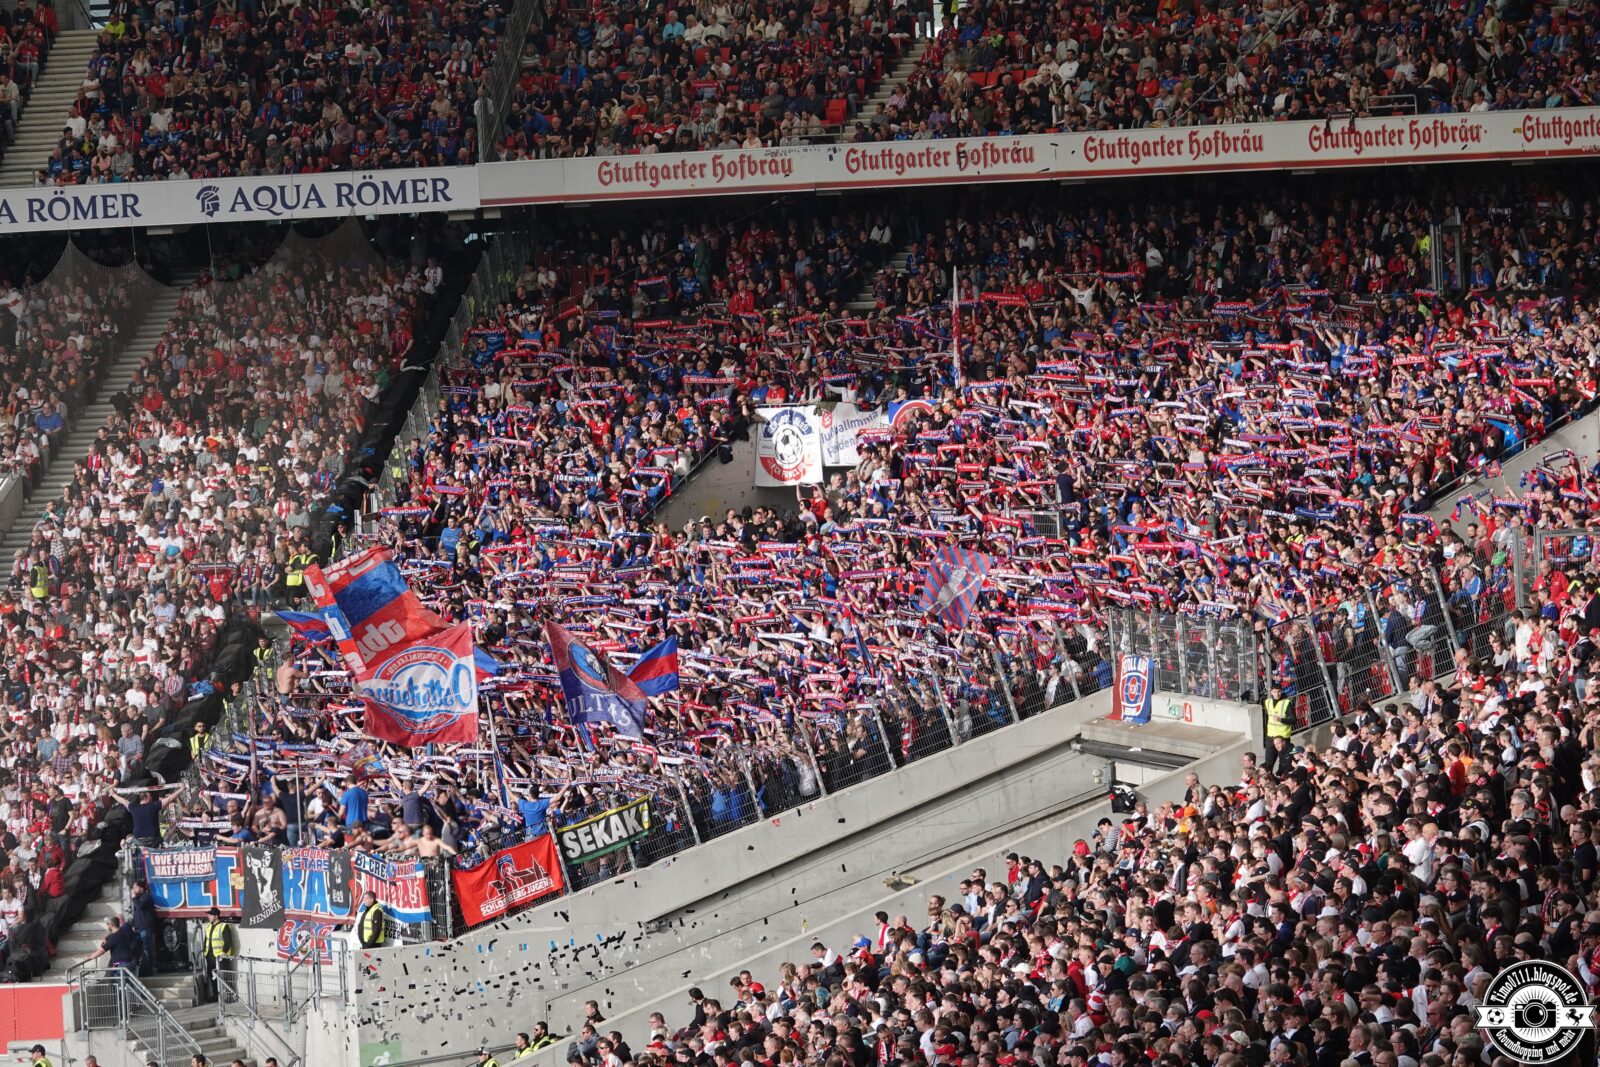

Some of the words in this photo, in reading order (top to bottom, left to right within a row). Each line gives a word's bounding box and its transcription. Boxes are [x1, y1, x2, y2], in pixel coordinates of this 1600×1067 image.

[1083, 135, 1184, 165] Stuttgarter
[1188, 128, 1264, 160] Hofbräu
[1308, 124, 1405, 155] Stuttgarter
[1409, 118, 1482, 150] Hofbräu
[845, 147, 951, 175] Stuttgarter
[955, 140, 1035, 171] Hofbräu
[598, 159, 707, 187] Stuttgarter
[26, 190, 142, 222] RÖMER
[228, 184, 327, 216] AQUA
[334, 174, 453, 207] RÖMER
[1185, 705, 1191, 720] 4
[150, 854, 172, 866] LOVE
[173, 850, 215, 865] FOOTBALL
[154, 865, 177, 876] HATE
[177, 862, 213, 875] RACISM
[292, 857, 330, 871] STARS
[249, 900, 283, 926] HENDRIK
